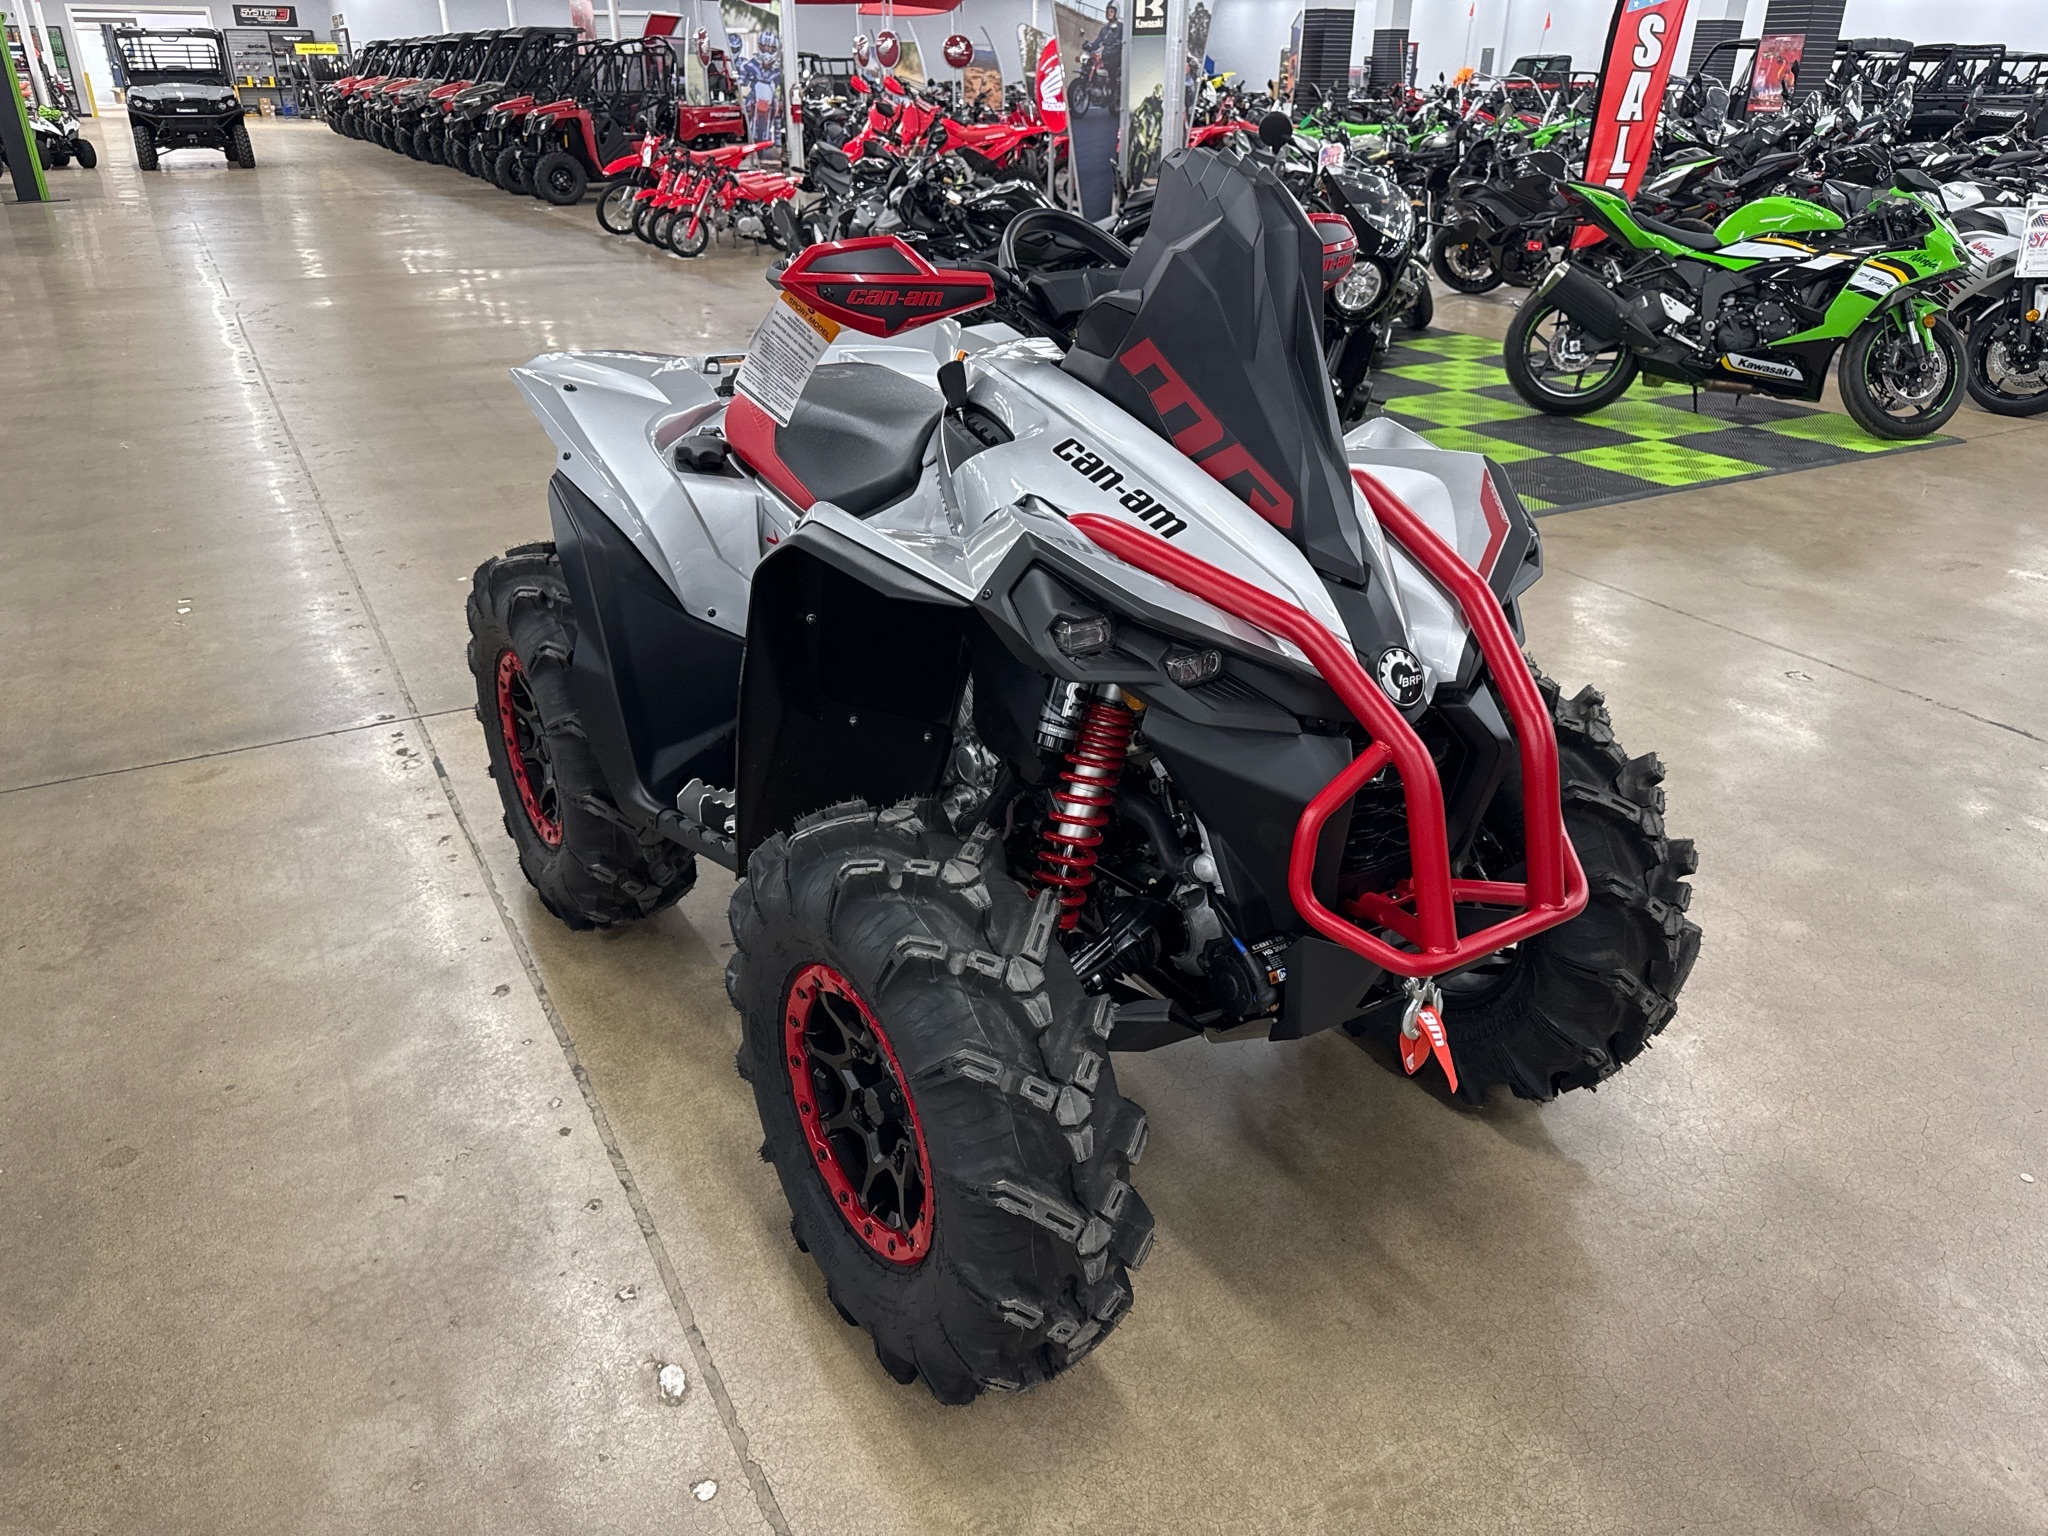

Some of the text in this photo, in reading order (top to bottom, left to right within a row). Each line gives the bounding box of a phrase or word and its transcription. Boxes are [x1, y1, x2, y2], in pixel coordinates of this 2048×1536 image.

[1135, 18, 1164, 28] Kawasaki
[1404, 44, 1414, 87] SUZUK
[1604, 12, 1667, 190] SAL
[1971, 241, 1995, 258] Ninja
[1909, 253, 1939, 269] Ninja
[846, 289, 944, 307] can-am
[788, 297, 829, 338] SPORT MODEL
[1738, 358, 1794, 377] Kawasaki
[1052, 438, 1187, 539] can-am
[1402, 674, 1422, 687] BRP
